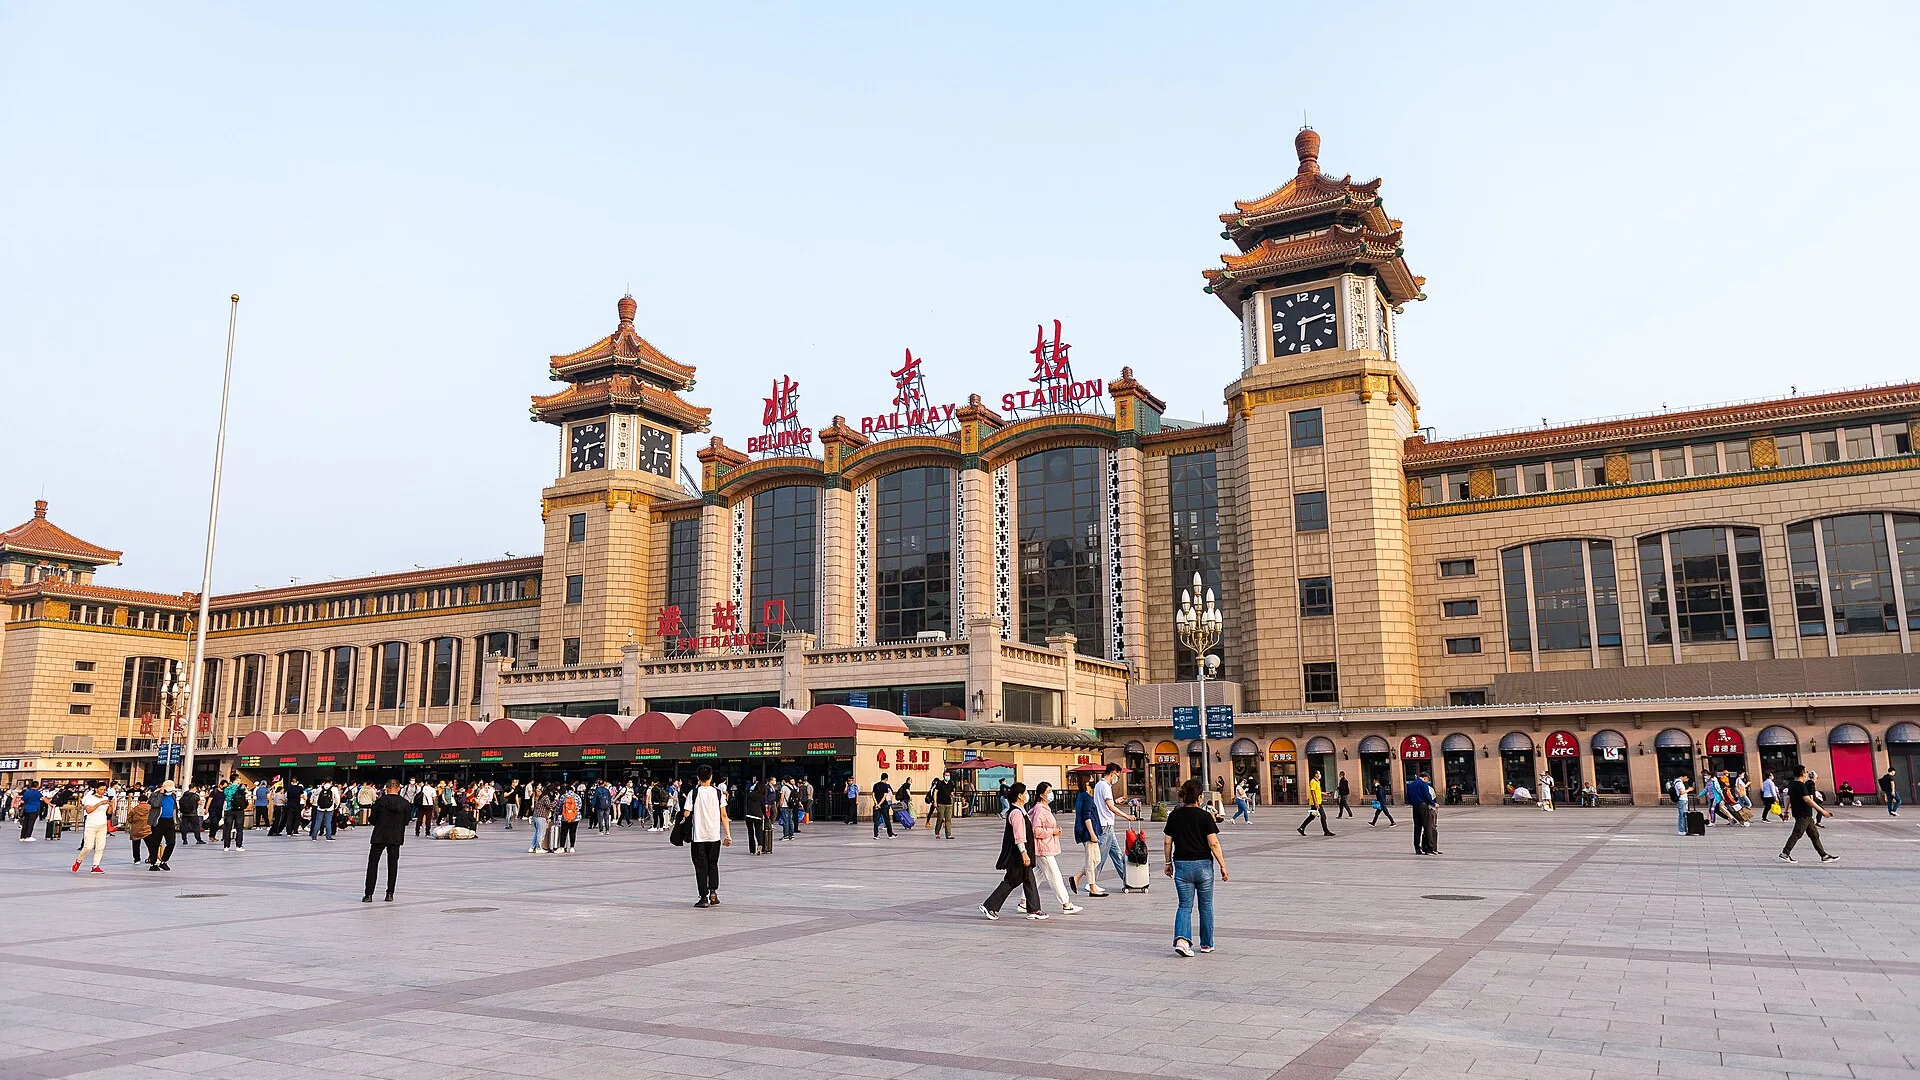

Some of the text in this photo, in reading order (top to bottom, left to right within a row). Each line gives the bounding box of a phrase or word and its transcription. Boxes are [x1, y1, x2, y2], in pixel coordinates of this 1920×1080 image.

[1296, 292, 1309, 303] 12
[1325, 313, 1336, 323] 3
[1272, 322, 1283, 332] 9
[1300, 343, 1311, 353] 6
[747, 379, 1103, 453] BEIJING RAILWAY STATION
[585, 424, 593, 432] 12
[652, 428, 660, 437] 12
[656, 599, 785, 637] 进站口
[679, 631, 766, 650] ENTRANCE
[1551, 747, 1574, 755] KFC
[896, 763, 930, 771] ENTRANCE
